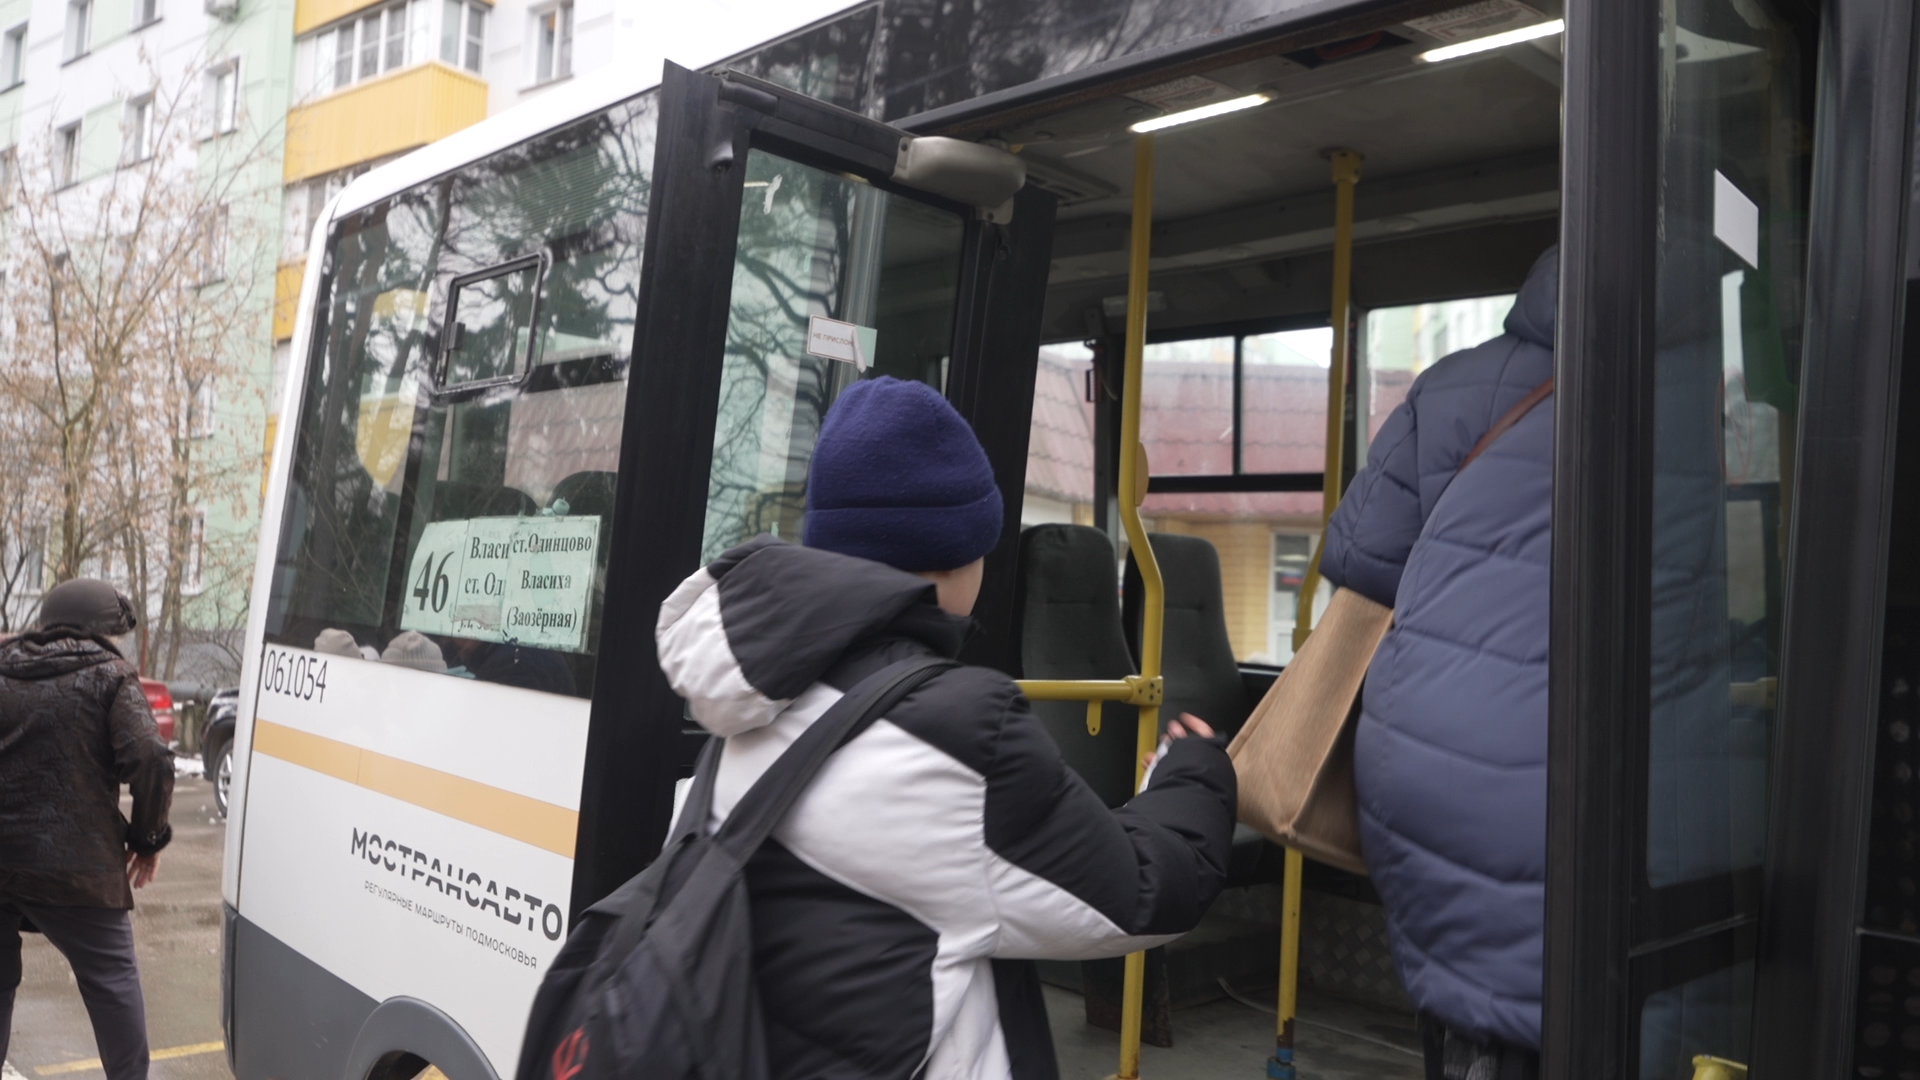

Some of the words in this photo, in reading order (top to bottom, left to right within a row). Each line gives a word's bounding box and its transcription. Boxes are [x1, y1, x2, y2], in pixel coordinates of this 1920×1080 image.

[813, 332, 822, 340] НЕ
[413, 551, 454, 613] 46
[464, 577, 480, 594] ст.
[521, 570, 572, 590] Власиха
[506, 606, 578, 633] (Заозёрная)
[264, 649, 328, 704] 061054
[351, 827, 563, 941] МОСТРАНСАВТО
[364, 880, 413, 911] РЕГУЛЯРНЫЕ
[414, 903, 464, 935] МАРШРУТЫ
[465, 926, 537, 969] ПОДМОСКОВЬЯ
